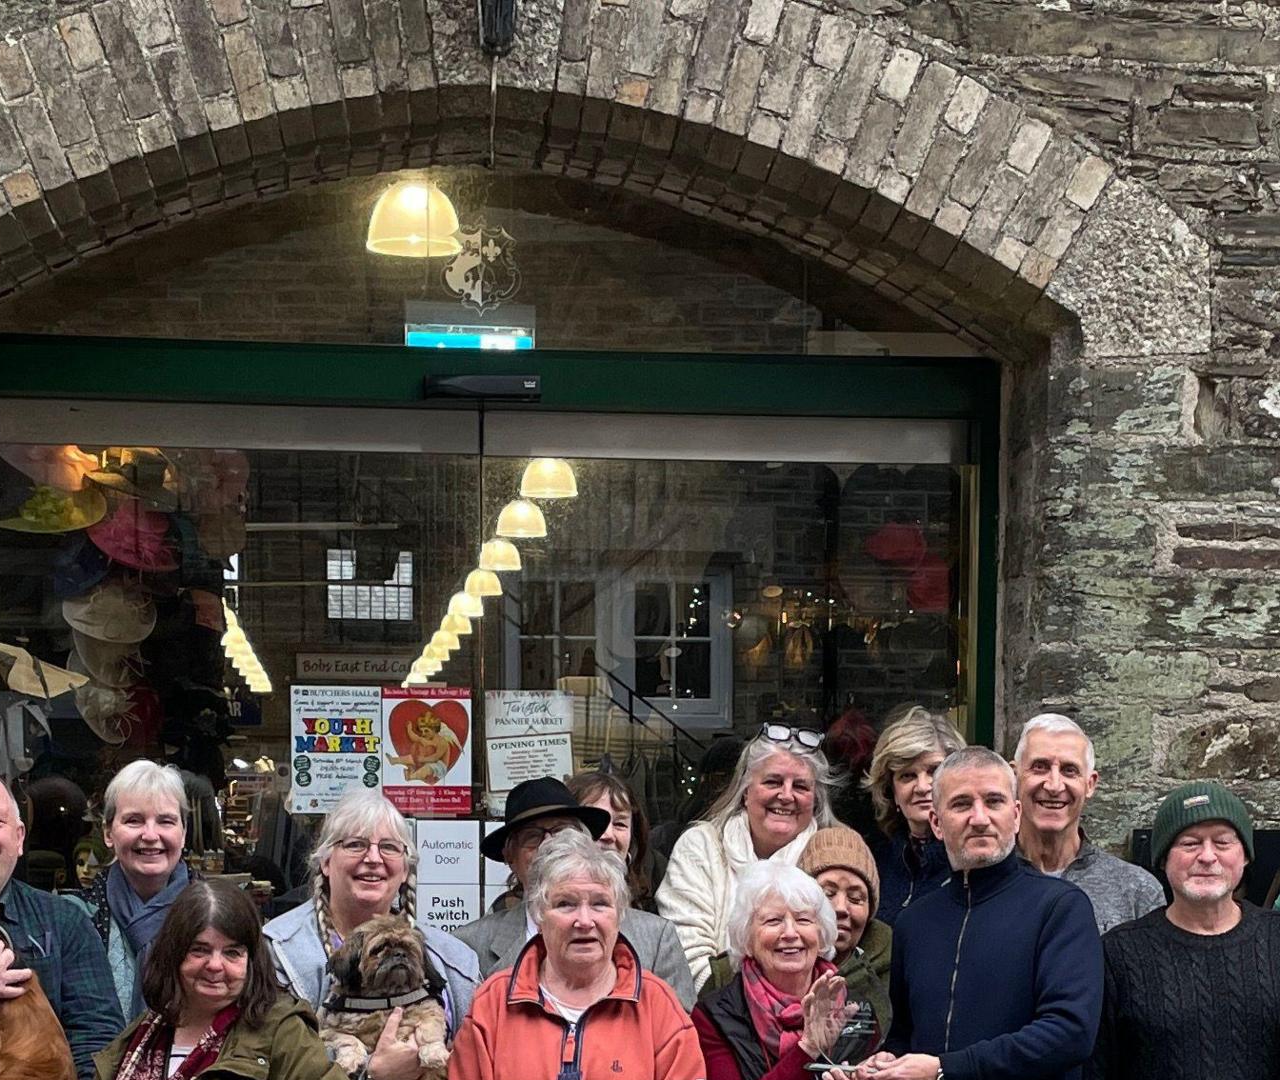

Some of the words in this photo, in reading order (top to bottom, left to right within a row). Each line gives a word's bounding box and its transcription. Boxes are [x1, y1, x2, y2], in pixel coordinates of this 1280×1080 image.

[335, 660, 360, 673] East
[364, 660, 391, 672] End
[302, 718, 373, 735] YOUTH
[295, 736, 380, 753] MARKET
[491, 740, 534, 750] OPENING
[539, 738, 567, 746] TIMES
[422, 840, 473, 849] Automatic
[435, 855, 460, 864] Door
[432, 897, 464, 907] Push
[428, 910, 469, 920] switch
